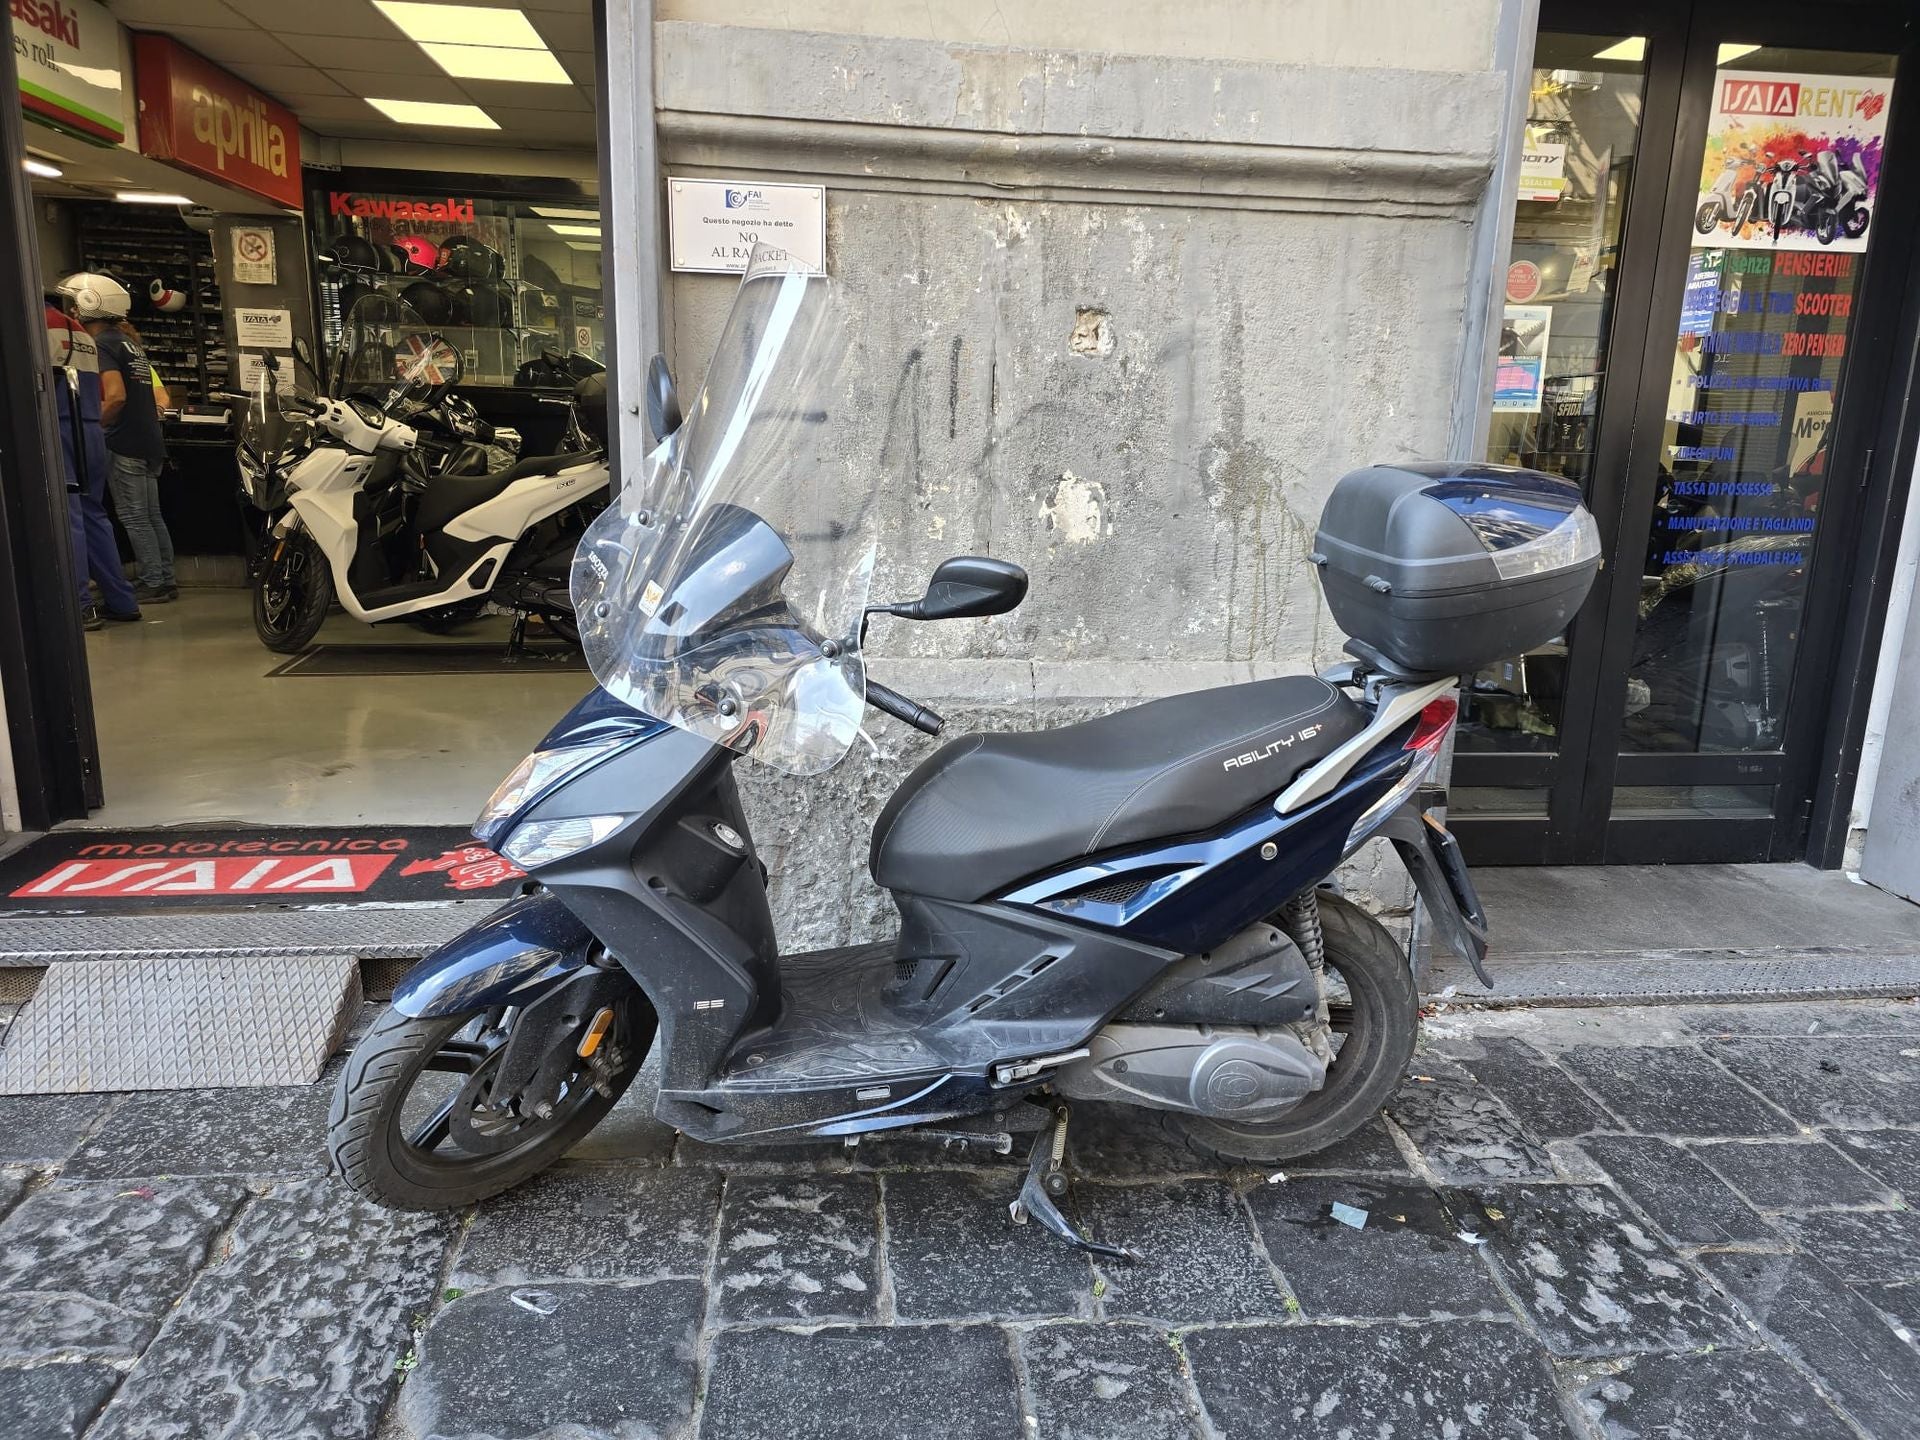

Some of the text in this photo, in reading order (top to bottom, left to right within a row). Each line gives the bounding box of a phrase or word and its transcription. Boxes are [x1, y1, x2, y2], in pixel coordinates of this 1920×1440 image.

[1723, 83, 1863, 118] ISAIA RENT
[192, 85, 287, 179] aprilia
[748, 190, 762, 199] FAI
[330, 191, 474, 223] Kawasaki
[703, 216, 730, 225] Questo
[732, 218, 762, 227] negozio
[774, 219, 793, 228] detto
[739, 231, 759, 244] NO
[711, 246, 729, 258] AL
[1731, 255, 1771, 274] senza
[1774, 251, 1852, 278] PENSIERI!!!
[1795, 293, 1852, 317] SCOOTER
[1782, 332, 1806, 356] ZERO
[1807, 333, 1846, 358] PENSIERI
[1687, 374, 1732, 389] POLIZZA
[1556, 402, 1582, 417] SFIDA
[1673, 481, 1774, 497] TASSA DI POSSESSO
[1668, 517, 1816, 532] MANUTENZIONE E TAGLIANDI
[1727, 551, 1782, 566] STRADALE
[1223, 734, 1295, 772] AGILITY
[77, 836, 409, 857] mototecnica
[28, 858, 357, 893] ISAIA
[693, 999, 725, 1010] 125
